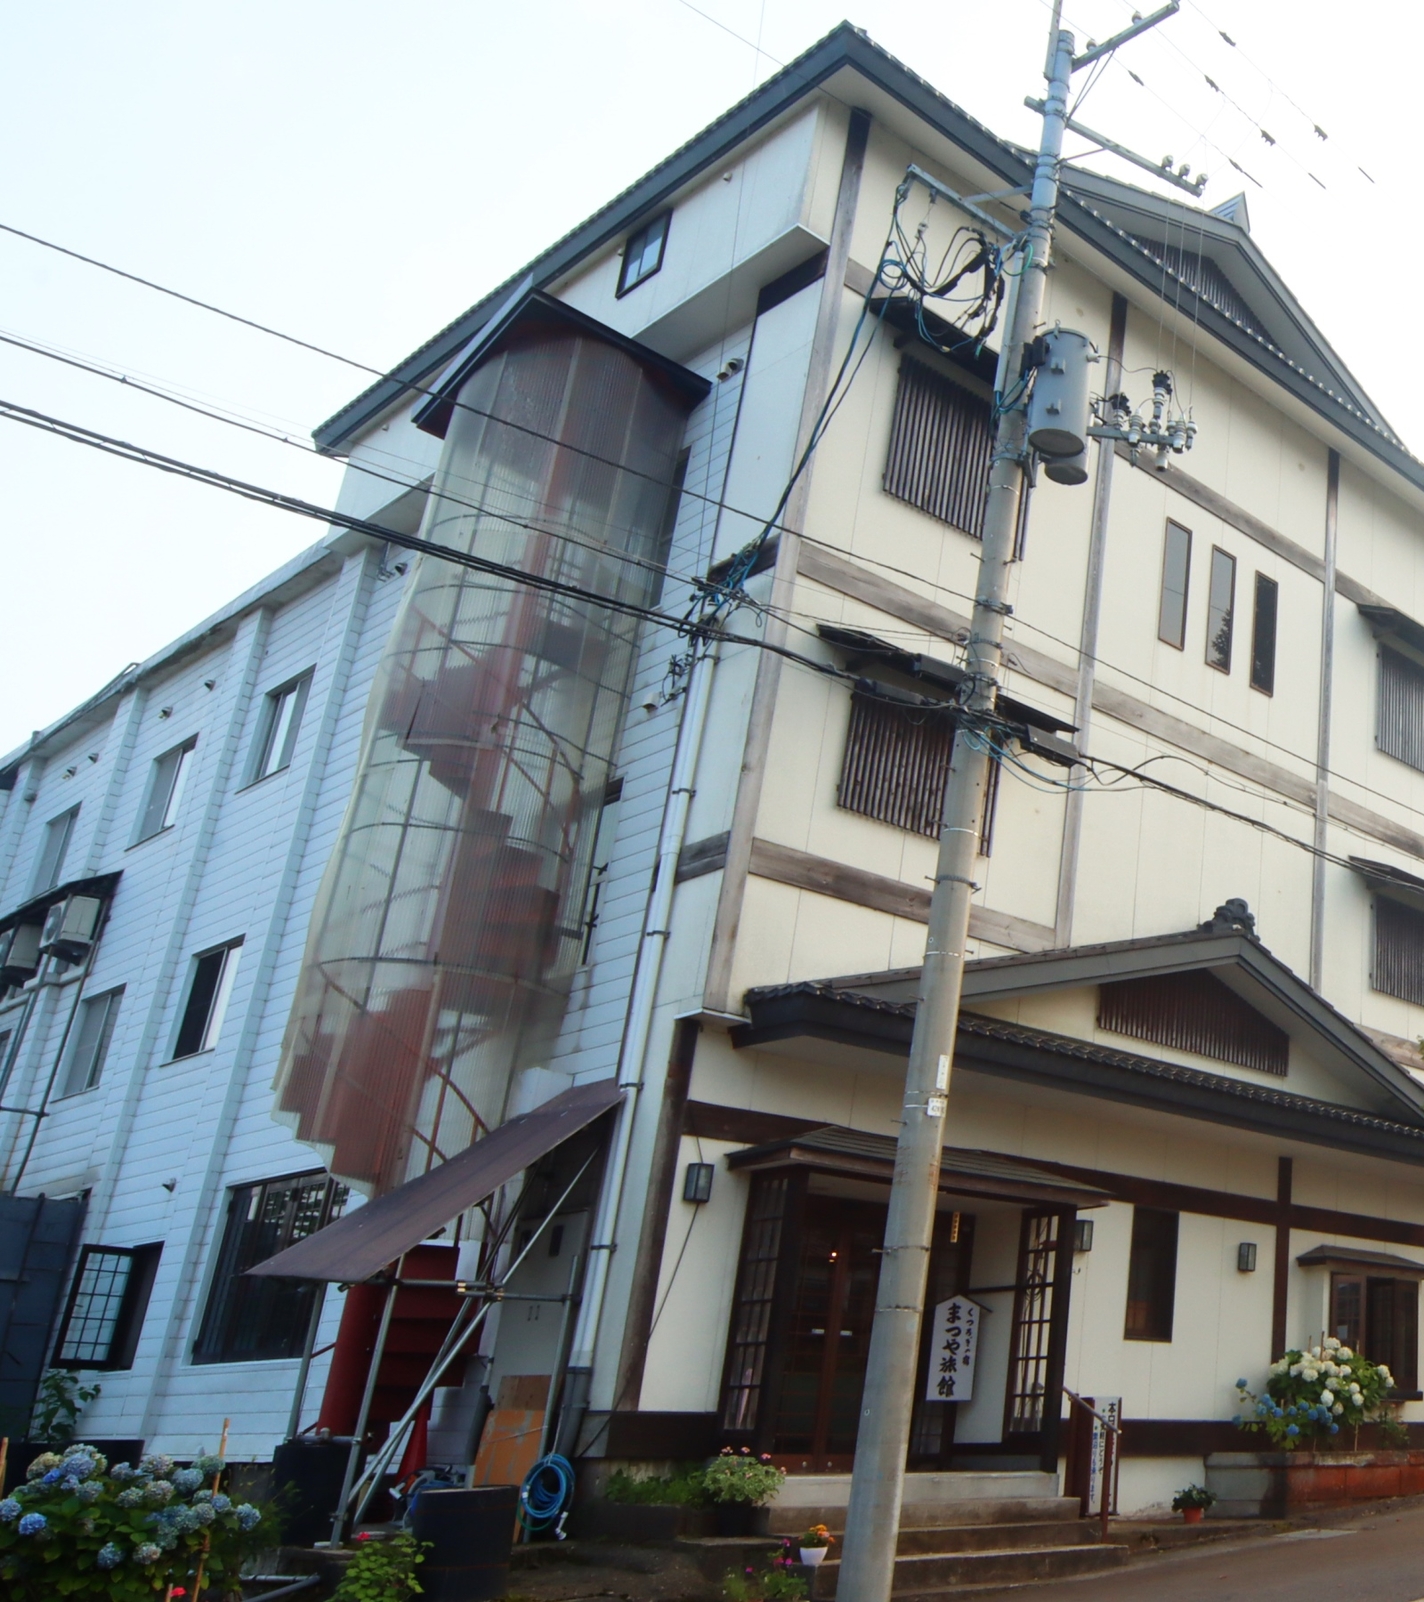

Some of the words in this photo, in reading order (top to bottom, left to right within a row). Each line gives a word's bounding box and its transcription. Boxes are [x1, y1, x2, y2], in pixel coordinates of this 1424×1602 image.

[937, 1302, 961, 1398] まつや旅館
[962, 1308, 975, 1367] くつろぎの宿
